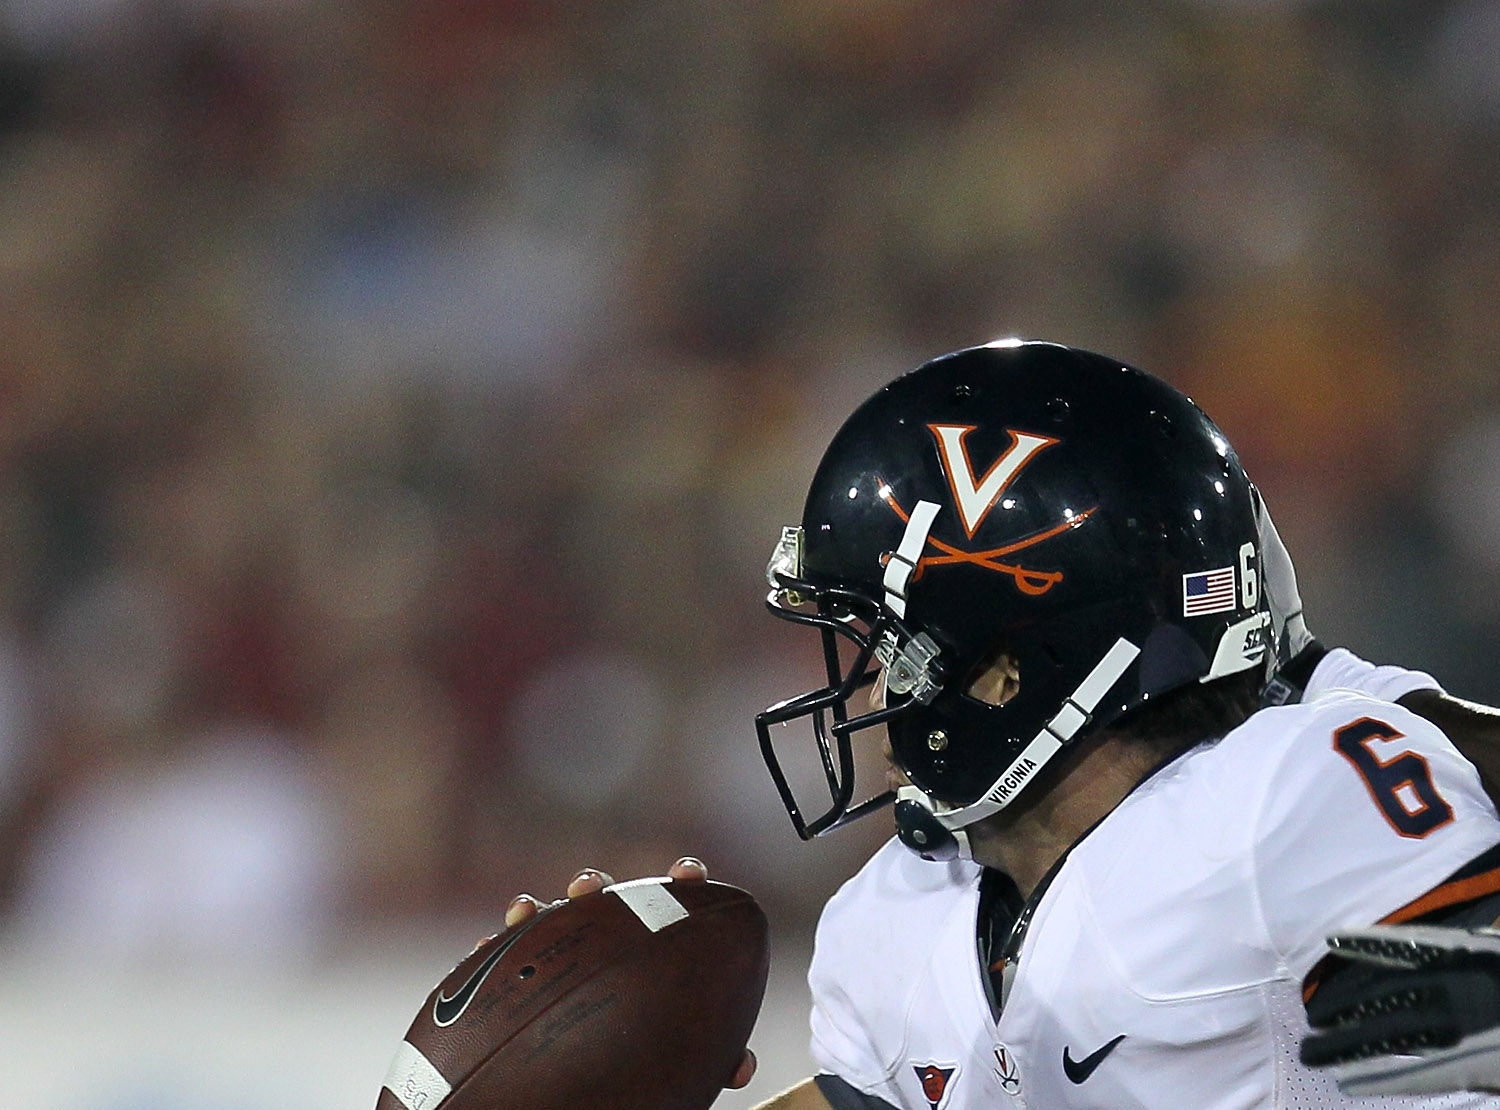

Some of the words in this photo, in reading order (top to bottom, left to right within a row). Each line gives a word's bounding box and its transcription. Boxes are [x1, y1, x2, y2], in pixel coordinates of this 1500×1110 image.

[927, 423, 1061, 540] V
[1240, 542, 1257, 609] 6
[988, 758, 1037, 804] VIRGINIA
[1333, 716, 1455, 839] 6
